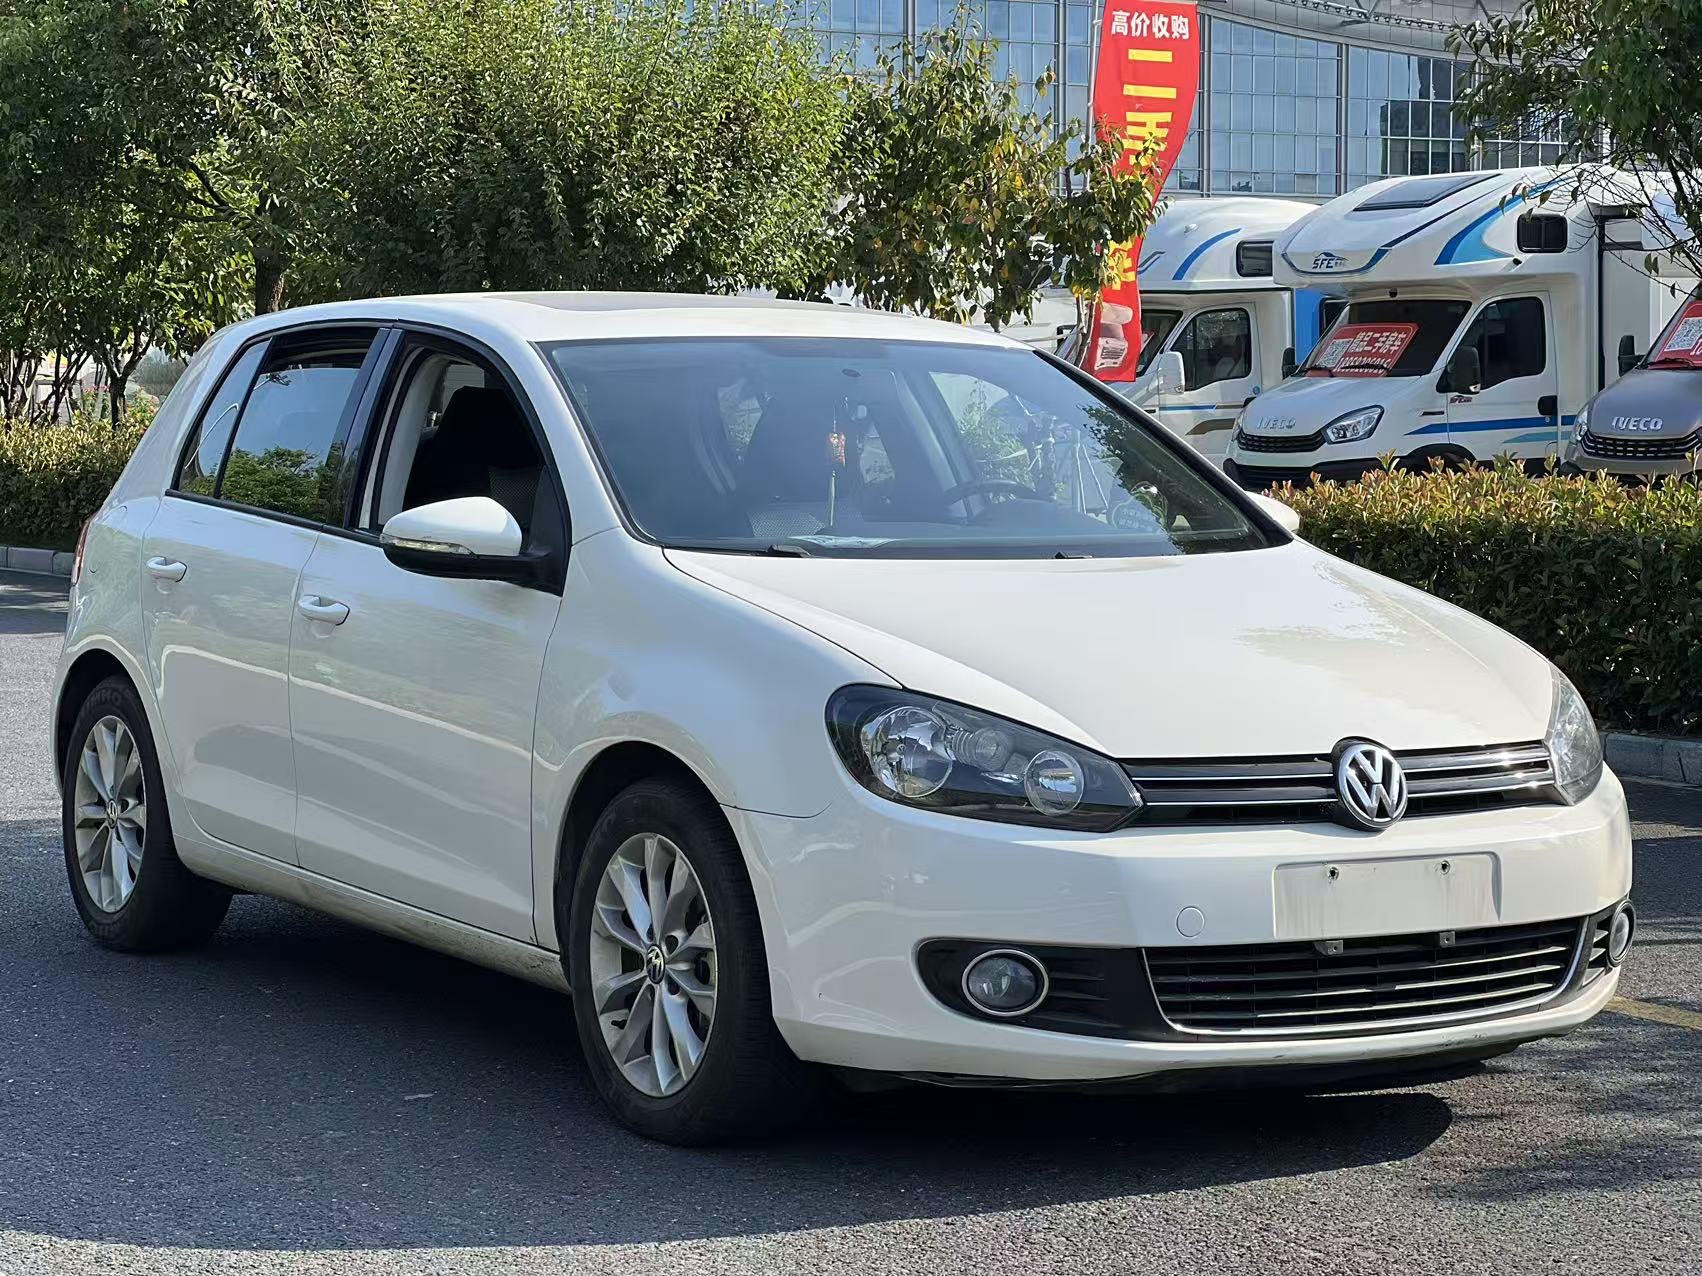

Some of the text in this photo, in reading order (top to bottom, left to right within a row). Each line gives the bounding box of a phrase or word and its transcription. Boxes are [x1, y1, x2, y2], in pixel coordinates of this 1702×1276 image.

[1111, 10, 1189, 40] 高价收购
[1312, 258, 1334, 269] SFE
[1257, 416, 1296, 430] IVECO
[1611, 416, 1663, 430] IVECO
